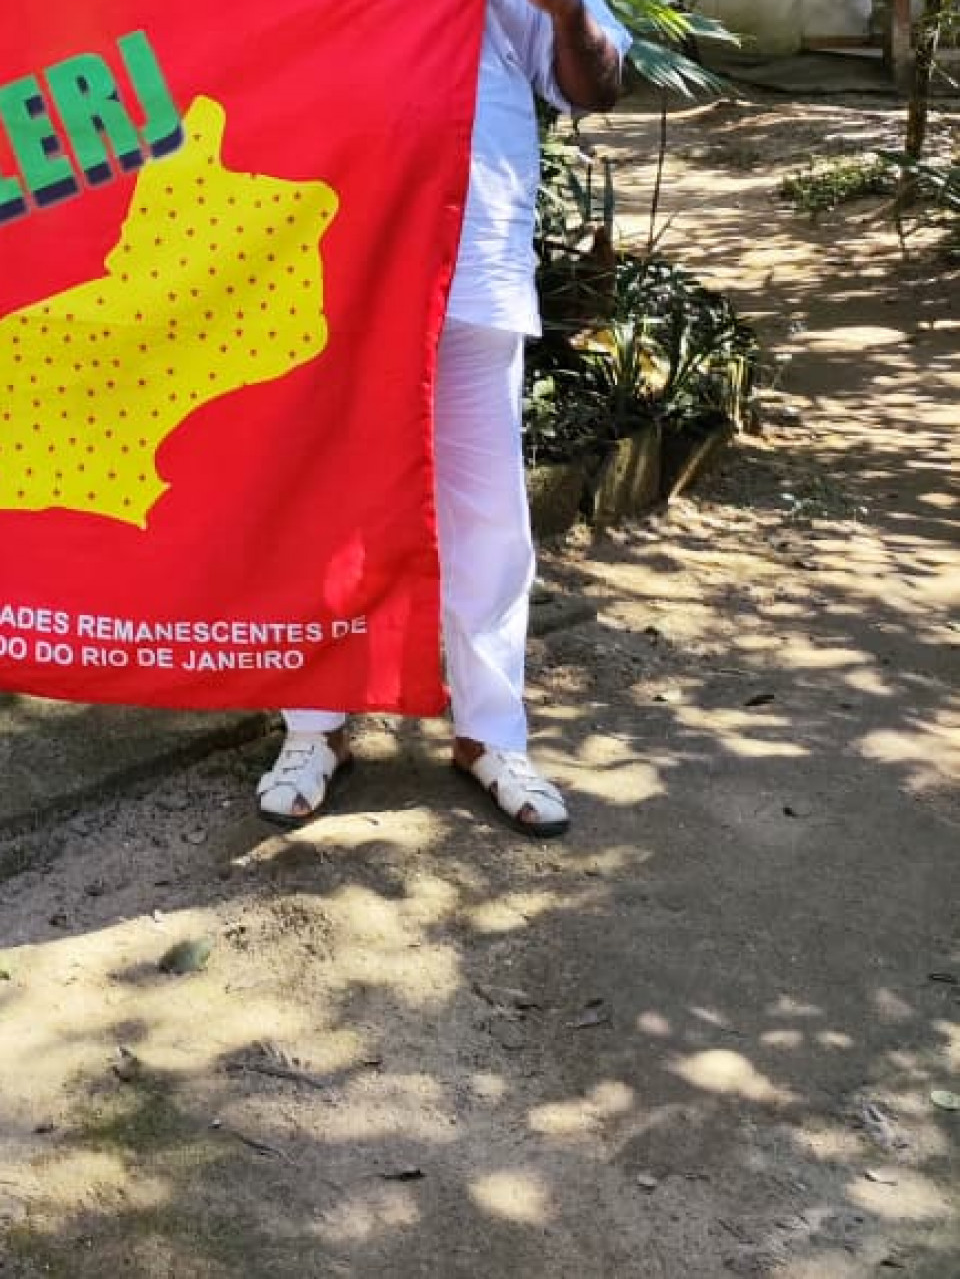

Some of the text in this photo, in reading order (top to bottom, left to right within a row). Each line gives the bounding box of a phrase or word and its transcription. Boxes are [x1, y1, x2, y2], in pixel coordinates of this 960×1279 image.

[76, 614, 324, 644] REMANESCENTES
[331, 615, 368, 639] DE
[34, 639, 74, 665] DO
[81, 645, 129, 667] RIO
[136, 647, 174, 667] DE
[181, 649, 305, 671] JANEIRO
